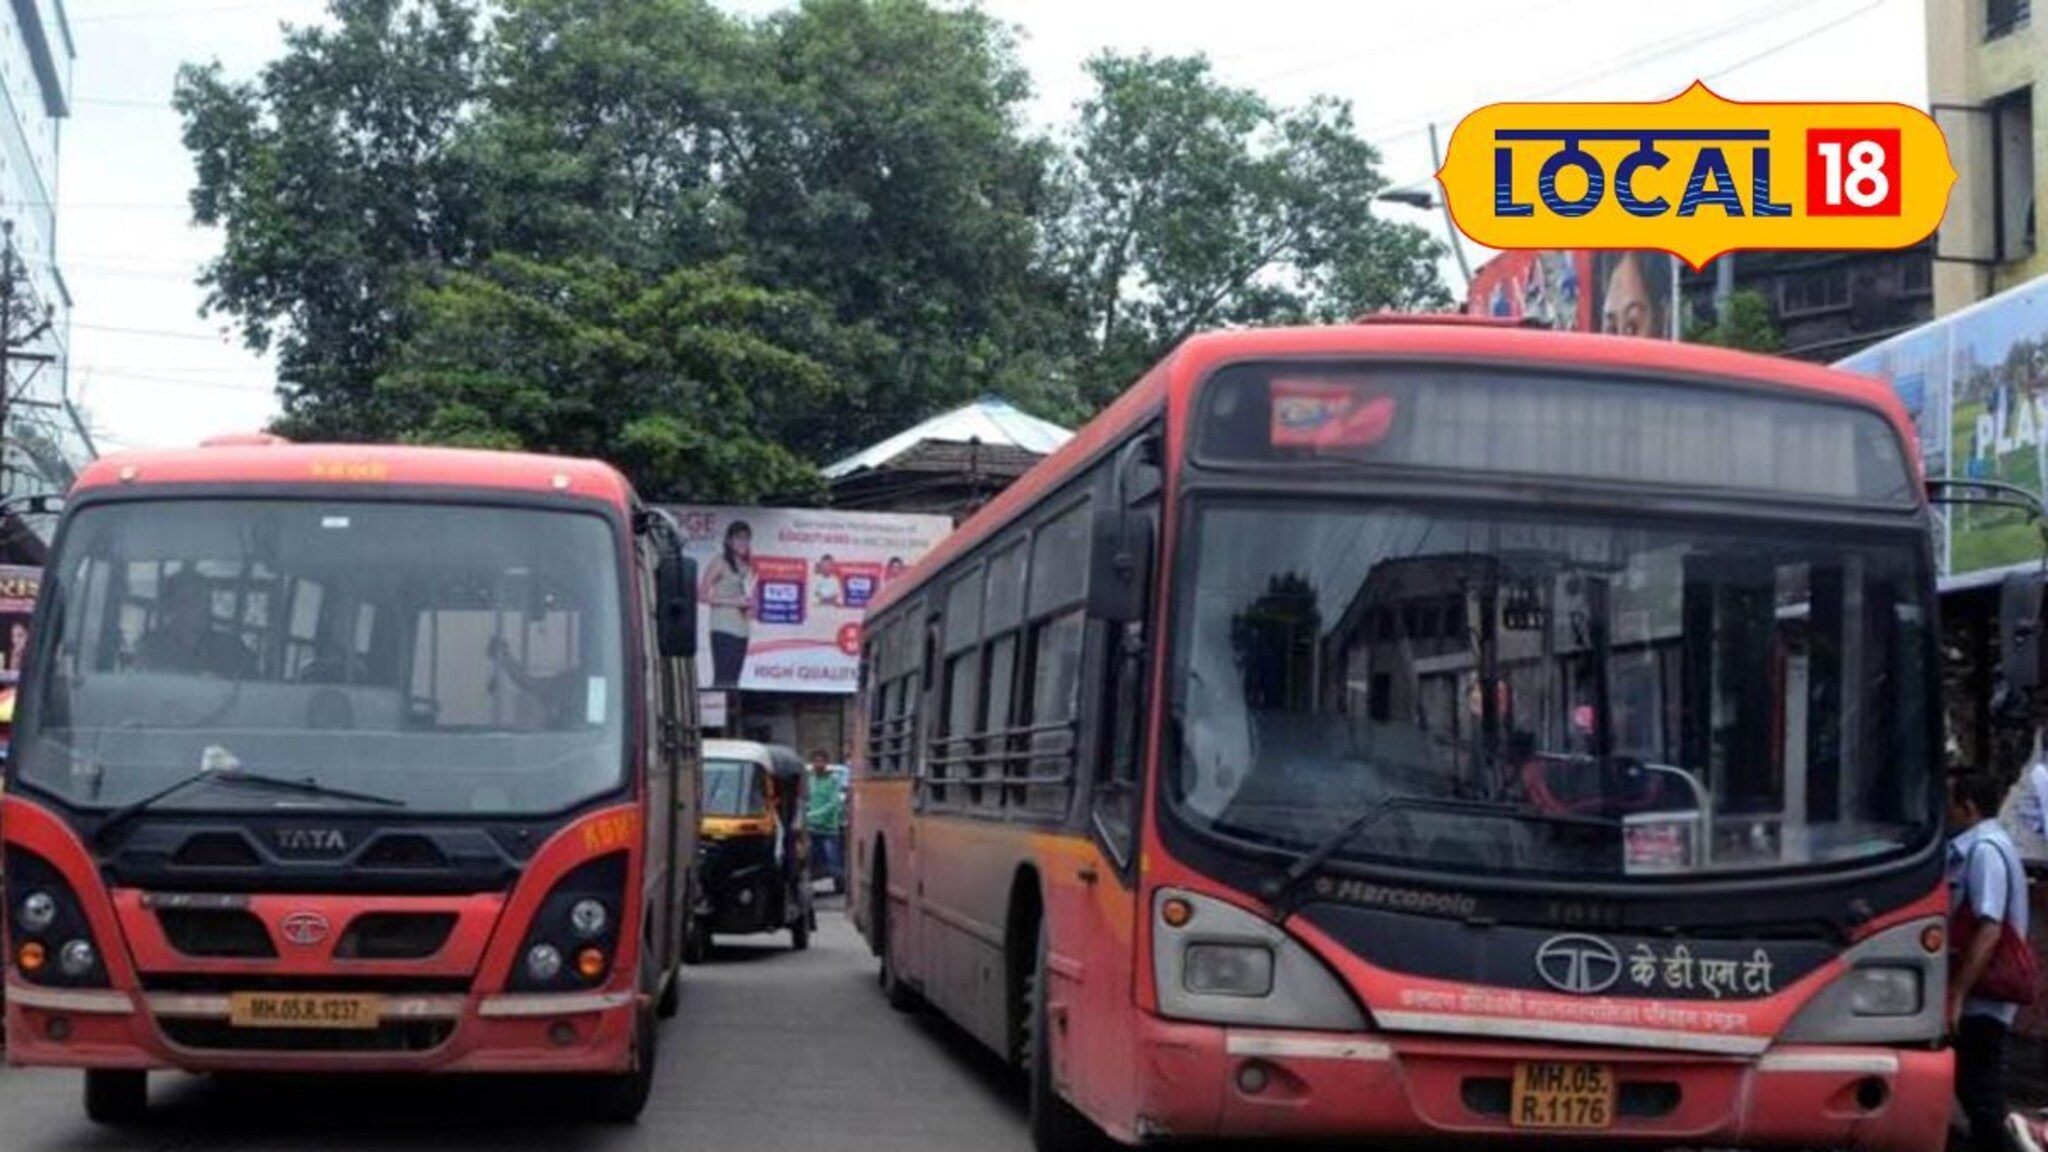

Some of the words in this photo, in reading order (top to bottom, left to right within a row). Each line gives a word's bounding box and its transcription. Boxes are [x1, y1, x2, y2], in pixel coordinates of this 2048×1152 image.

[754, 665, 794, 680] HIGH
[277, 829, 346, 849] TATA
[1526, 1064, 1608, 1093] MH.05.
[1521, 1095, 1605, 1124] R.1176
